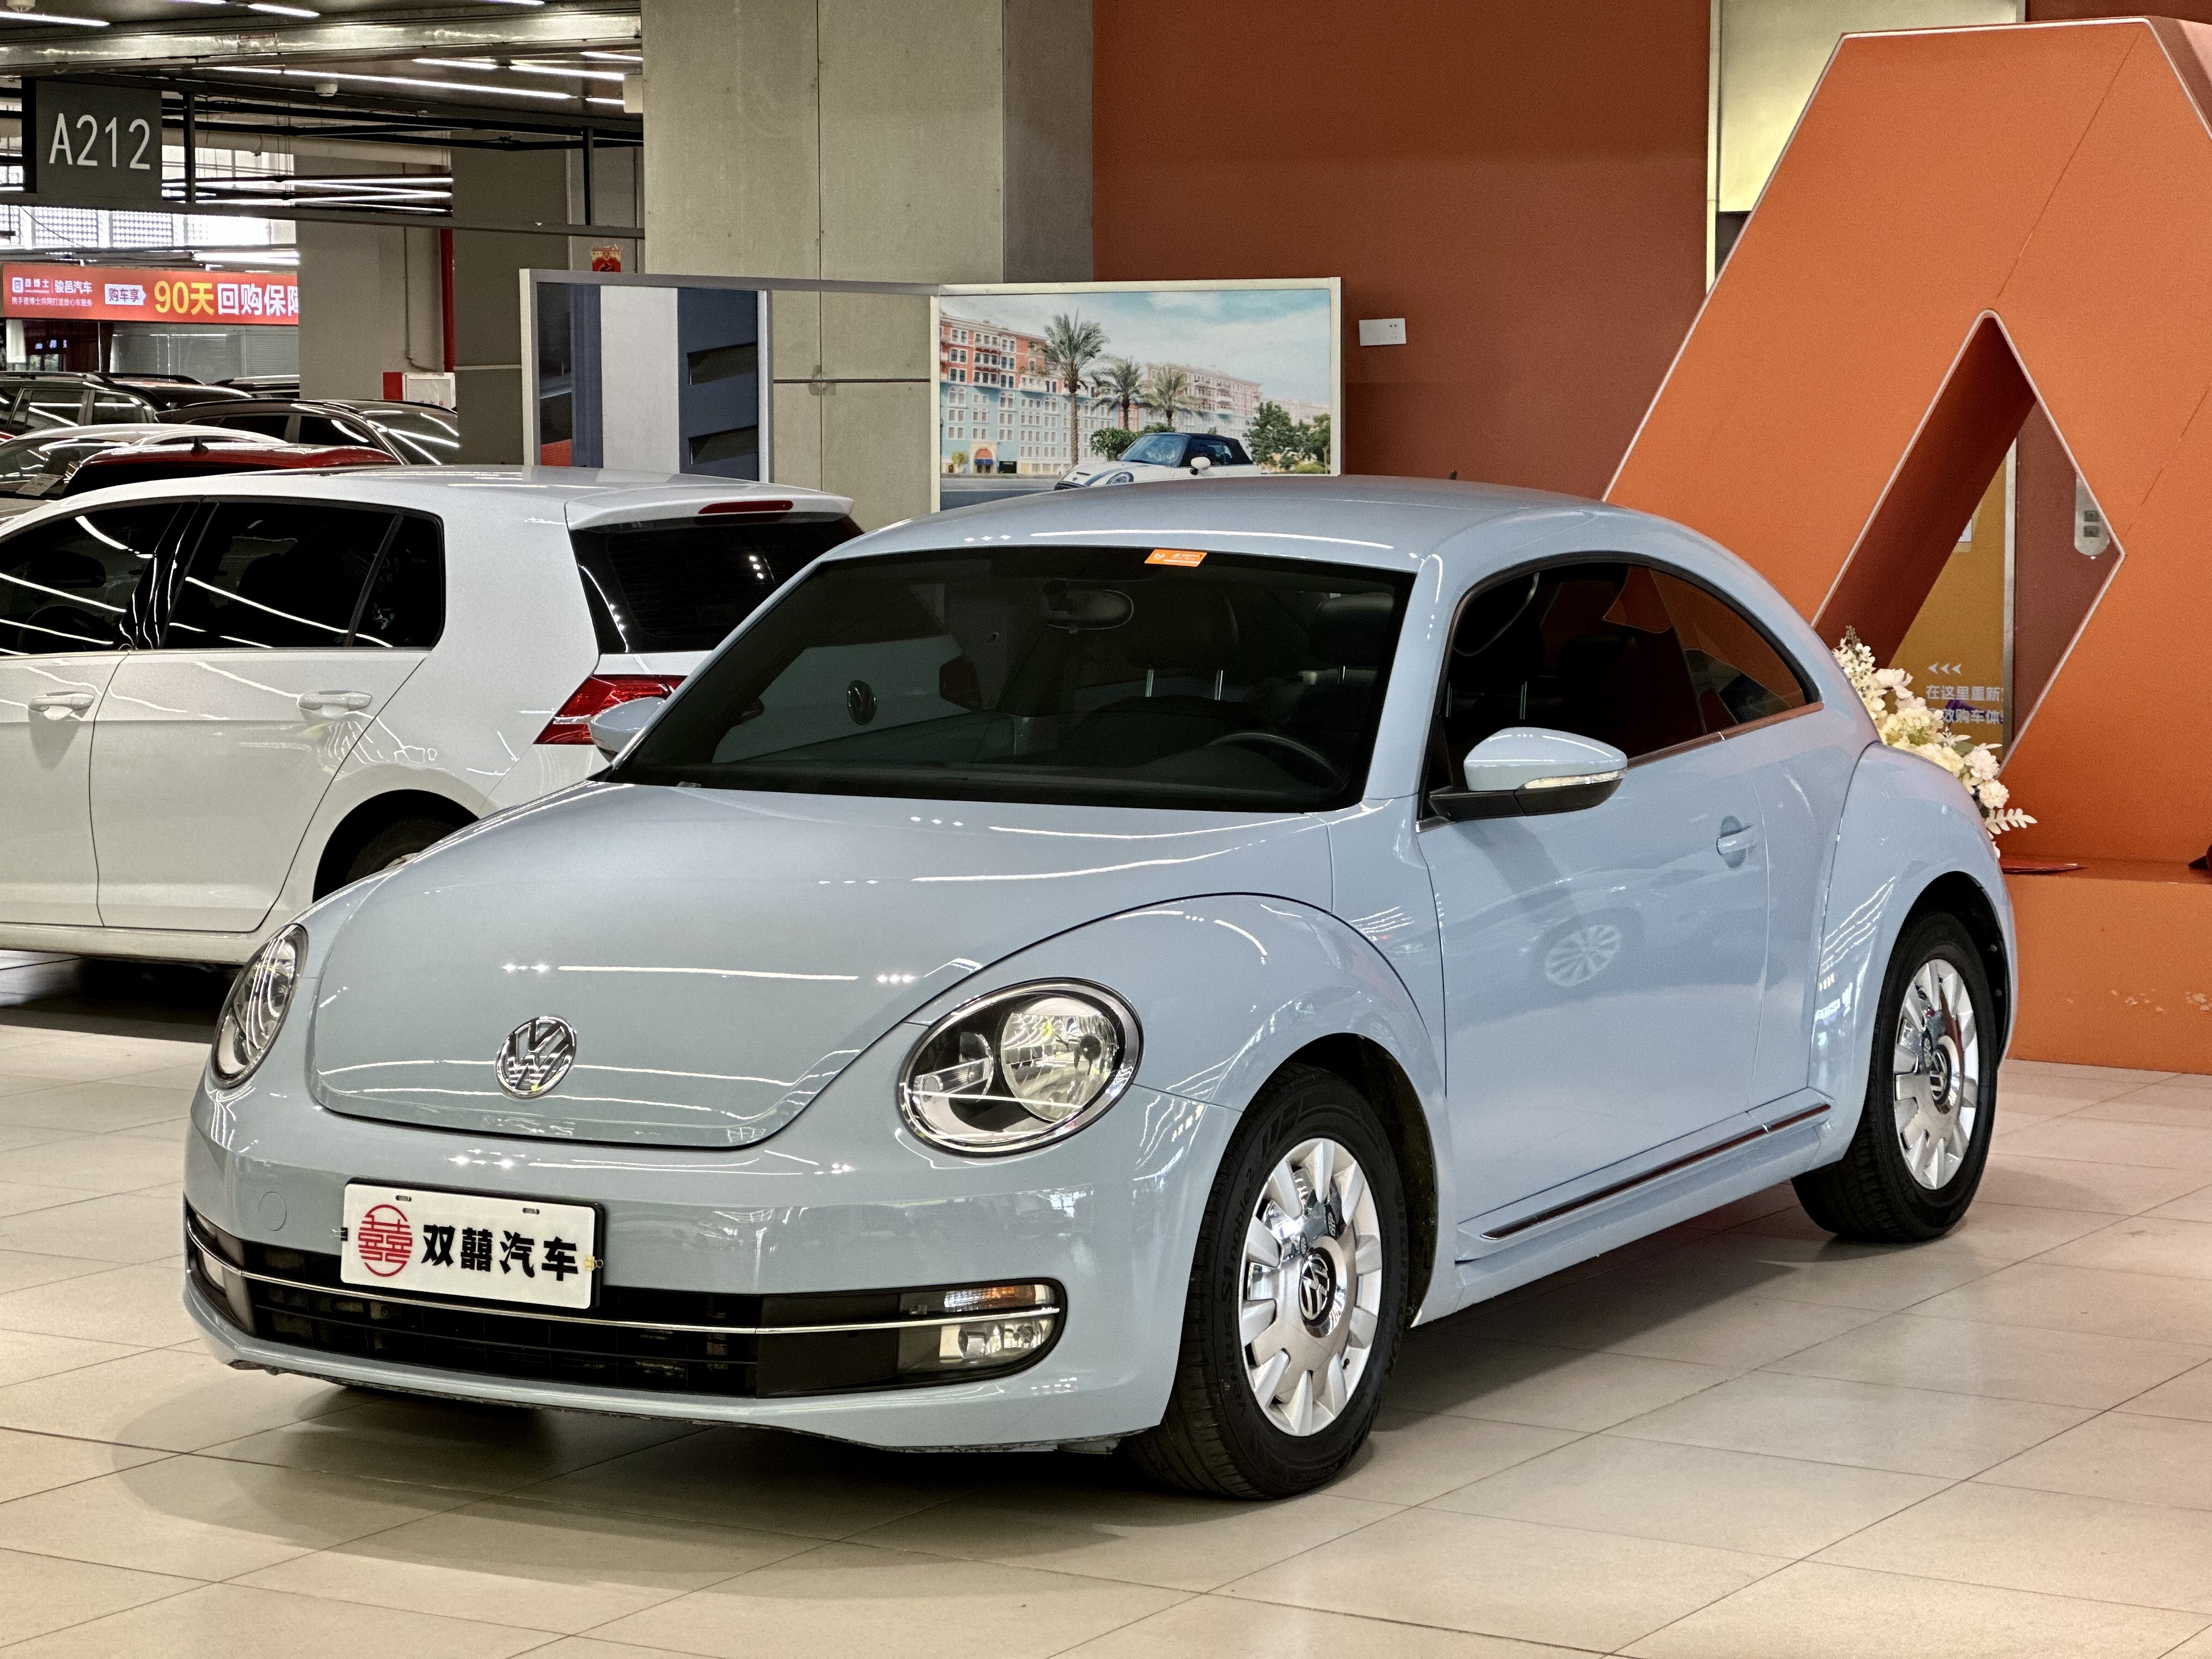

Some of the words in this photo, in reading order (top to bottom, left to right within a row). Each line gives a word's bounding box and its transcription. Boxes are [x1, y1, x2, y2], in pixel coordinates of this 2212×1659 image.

[49, 112, 151, 170] A212
[54, 280, 93, 295] 骏邑汽车
[109, 288, 140, 302] 购车享
[1926, 685, 2004, 702] 在这里重新
[1927, 708, 2004, 724] 效购车体
